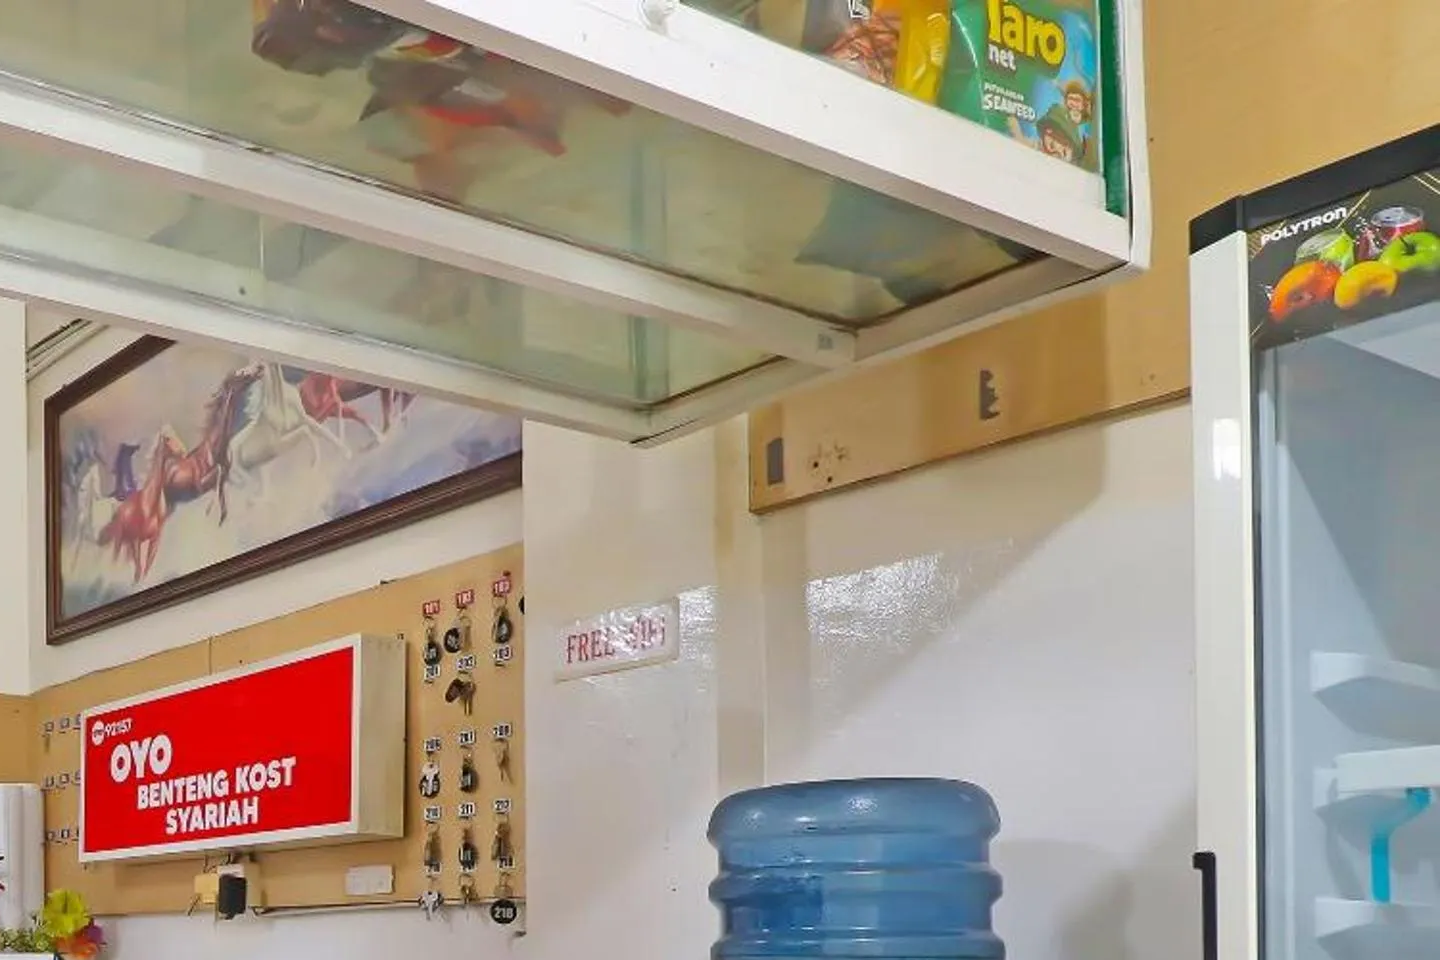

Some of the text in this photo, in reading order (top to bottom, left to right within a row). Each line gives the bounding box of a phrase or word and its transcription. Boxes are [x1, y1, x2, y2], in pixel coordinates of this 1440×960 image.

[988, 43, 1017, 71] net
[981, 94, 1036, 120] SEAWEED
[1260, 206, 1348, 246] POLYTRON
[566, 627, 616, 663] FREE
[111, 734, 172, 782] OYO
[137, 756, 297, 810] BENTENG KOST
[165, 796, 259, 835] SYARIAH
